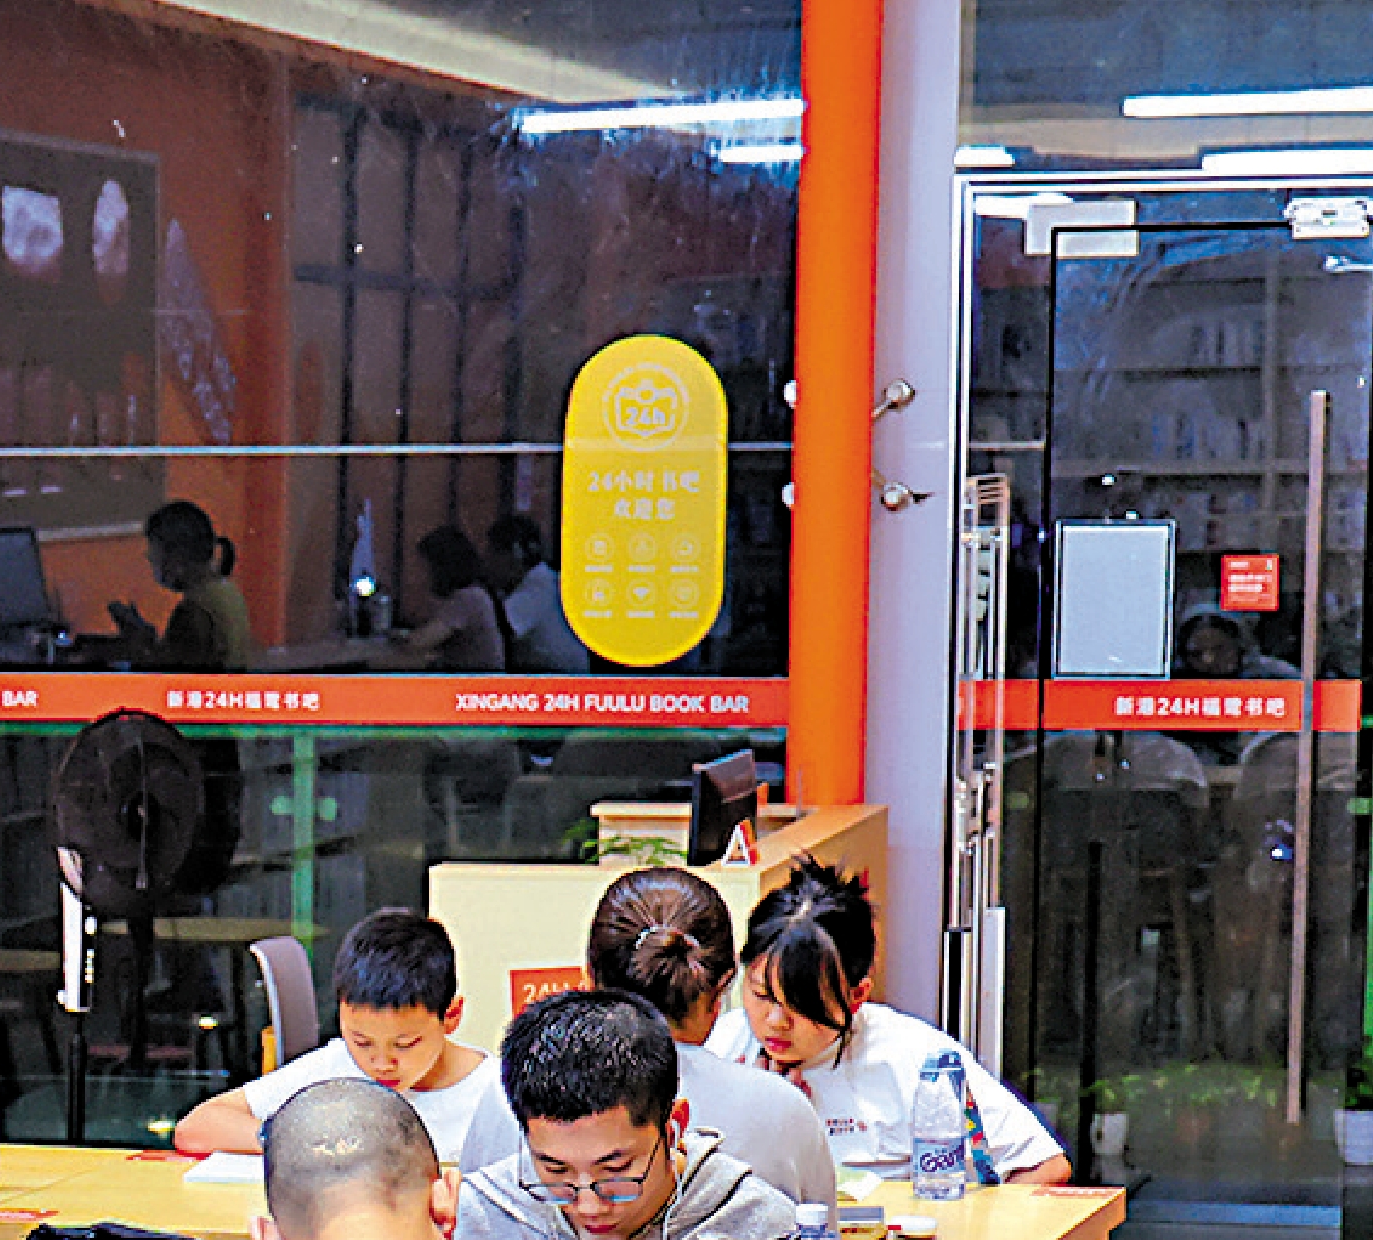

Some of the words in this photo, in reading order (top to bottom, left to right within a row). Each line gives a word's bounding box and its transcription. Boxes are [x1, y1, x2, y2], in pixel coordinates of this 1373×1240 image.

[2, 691, 39, 708] BAR
[455, 693, 539, 712] XINGANG
[543, 693, 579, 712] 24H
[584, 693, 645, 713] FUULU
[649, 693, 705, 713] BOOK
[710, 695, 749, 714] BAR
